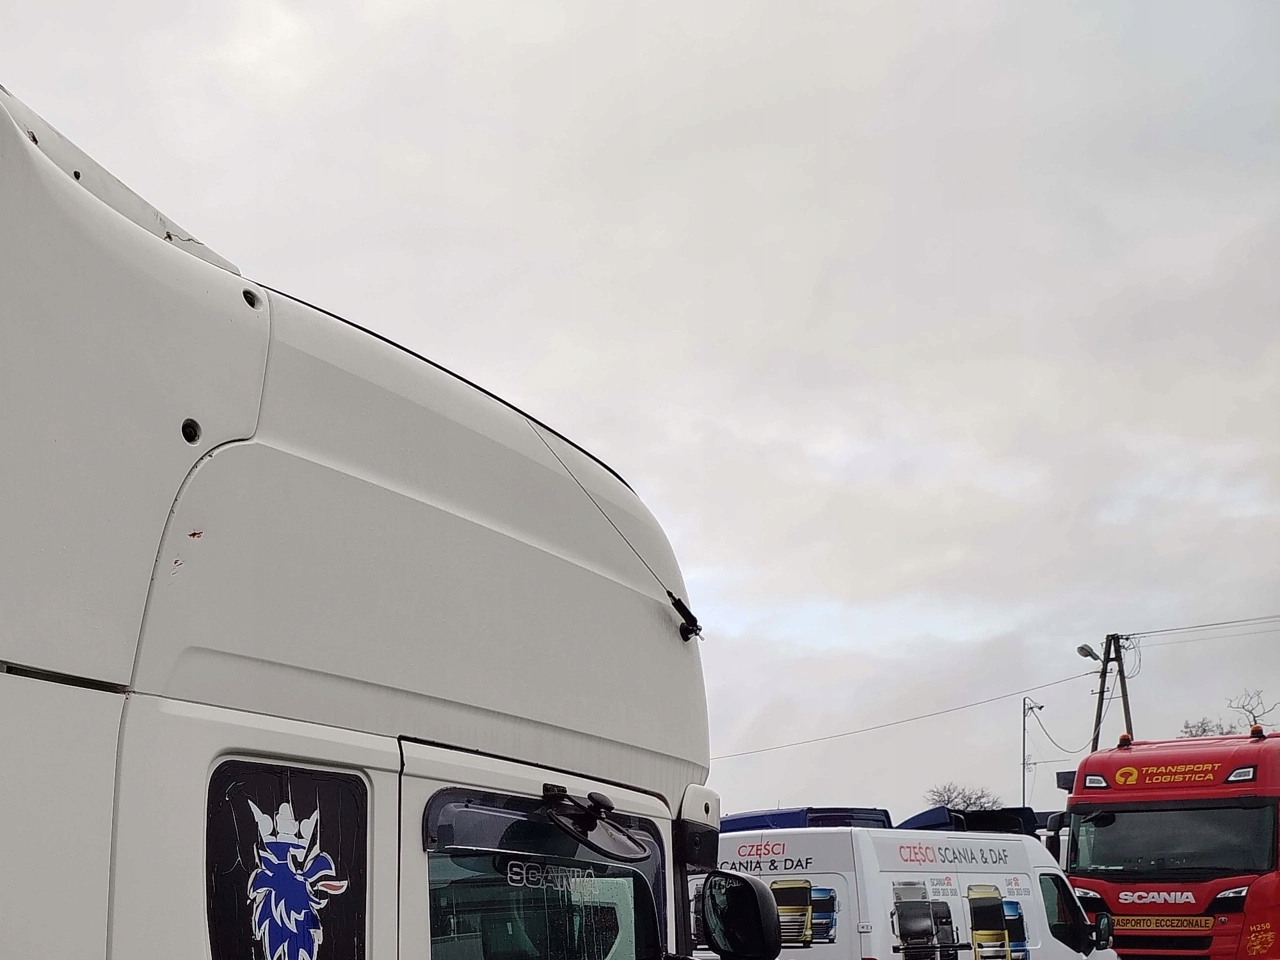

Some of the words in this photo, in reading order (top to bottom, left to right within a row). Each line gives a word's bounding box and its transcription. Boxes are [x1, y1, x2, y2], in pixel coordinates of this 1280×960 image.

[1141, 763, 1221, 774] TRANSPORT
[1145, 773, 1214, 783] LOGISTICA
[737, 841, 786, 858] CZĘŚCI
[898, 842, 937, 866] CZĘŚCI
[938, 847, 978, 864] SCANIA
[980, 848, 989, 864] &
[989, 848, 1009, 865] DAF
[768, 860, 778, 871] &
[784, 857, 813, 870] DAF
[507, 861, 599, 894] SCANIA
[1118, 891, 1196, 904] SCANIA
[1155, 918, 1210, 928] ECCEZIONALE
[1250, 922, 1271, 931] H250
